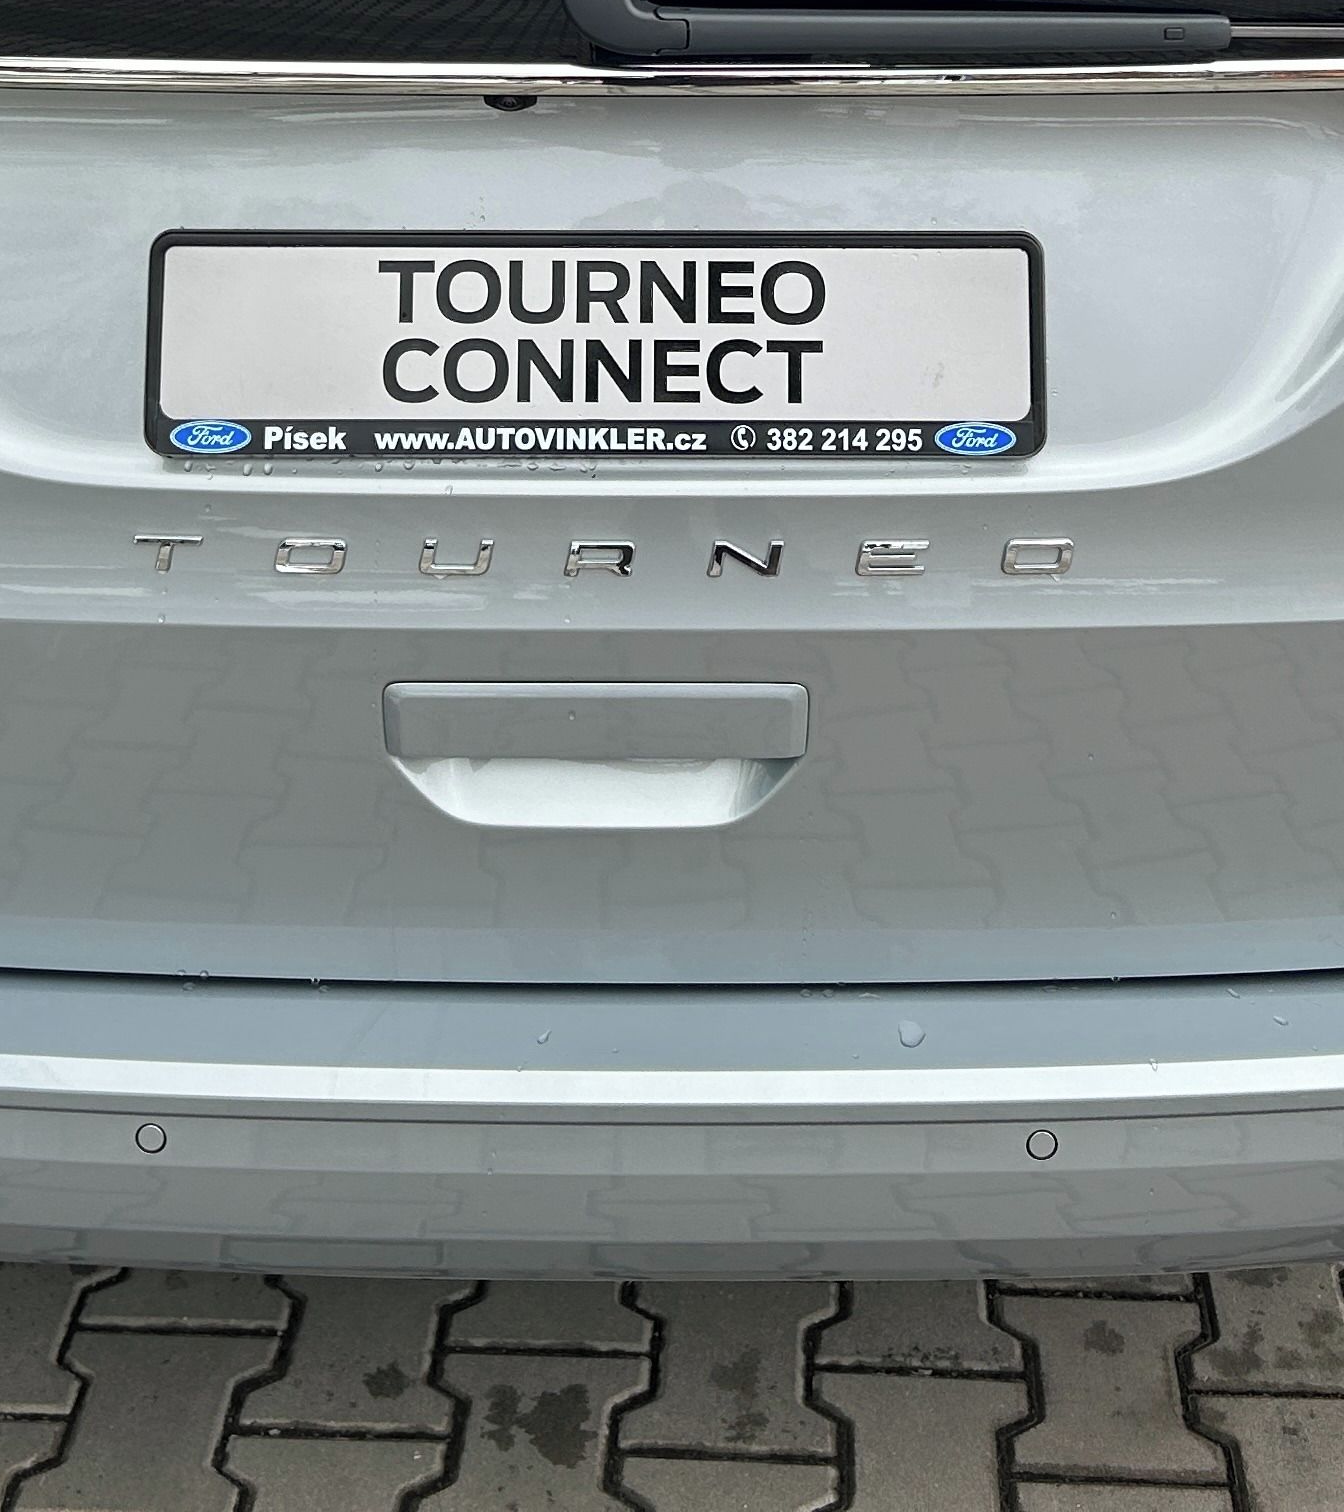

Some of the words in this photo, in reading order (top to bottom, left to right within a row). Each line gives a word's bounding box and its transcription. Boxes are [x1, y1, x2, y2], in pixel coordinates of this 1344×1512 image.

[379, 260, 825, 325] TOURNEO
[383, 339, 823, 404] CONNECT
[265, 426, 346, 449] Písek
[375, 428, 706, 450] www.AUTOVINKLER.cz
[767, 428, 812, 450] 382
[822, 428, 868, 450] 214
[876, 429, 922, 450] 295
[132, 534, 1076, 580] TOURNEO
